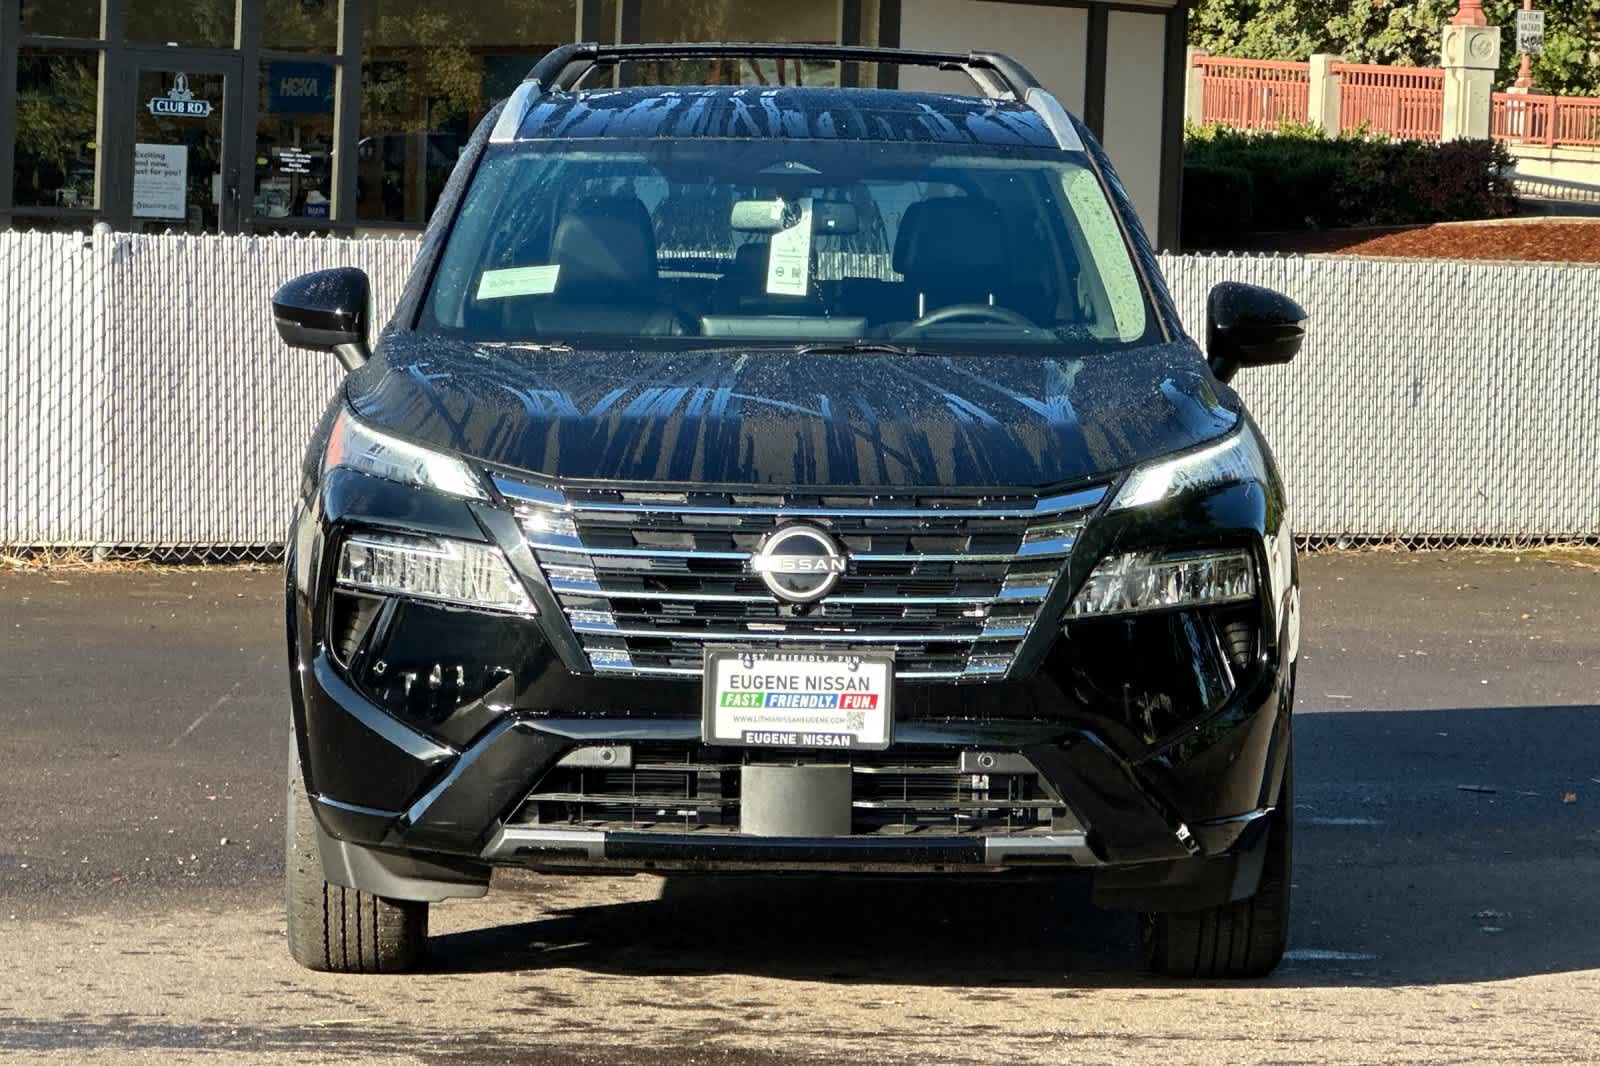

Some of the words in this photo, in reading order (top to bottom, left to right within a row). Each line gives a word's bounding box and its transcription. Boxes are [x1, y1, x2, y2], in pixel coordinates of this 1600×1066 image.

[157, 100, 185, 113] CLUB
[187, 102, 207, 114] RD.
[730, 675, 799, 690] EUGENE
[805, 676, 870, 691] NISSAN
[726, 693, 760, 706] FAST.
[769, 695, 835, 708] FRIENDLY.
[844, 696, 874, 709] FUN.
[745, 732, 797, 745] EUGENE
[802, 734, 850, 746] NISSAN
